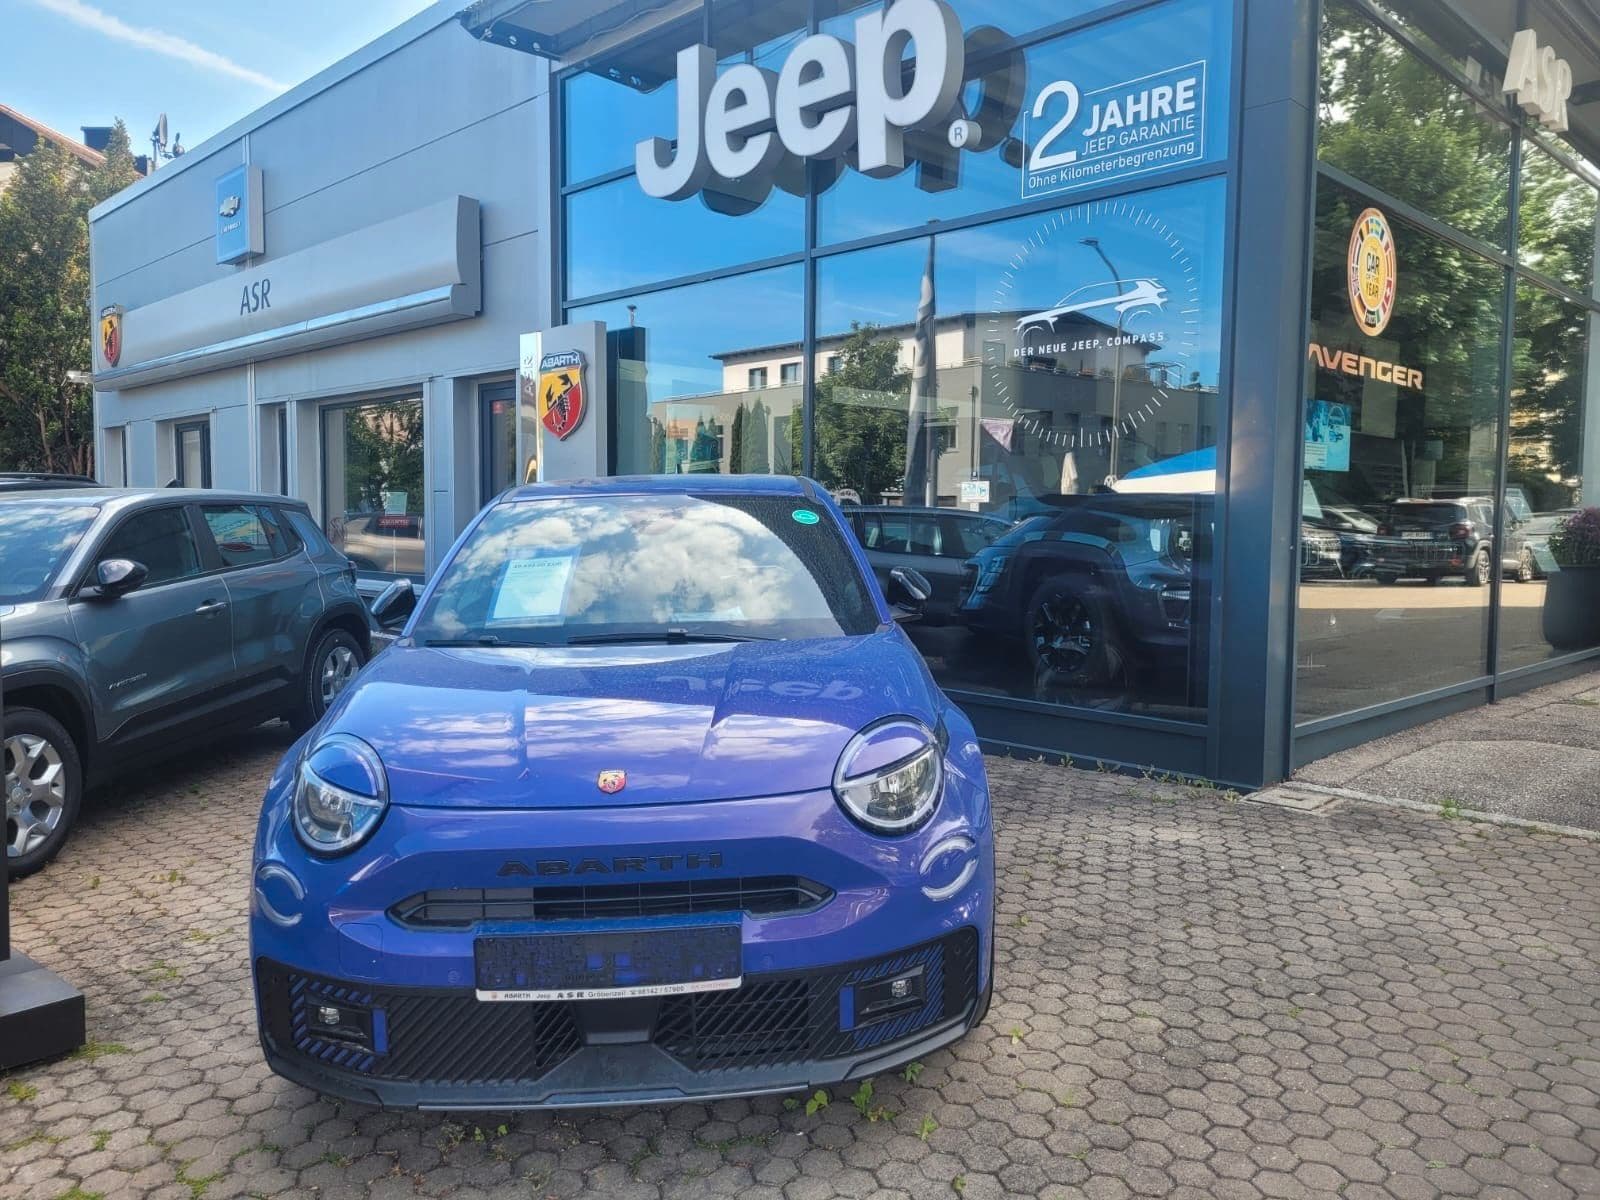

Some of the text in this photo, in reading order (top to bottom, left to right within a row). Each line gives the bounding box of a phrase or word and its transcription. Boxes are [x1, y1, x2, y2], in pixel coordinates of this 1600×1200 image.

[636, 0, 963, 200] Jeep
[1502, 28, 1572, 132] ASR
[1029, 80, 1079, 171] 2
[1082, 77, 1196, 137] JAHRE
[1081, 114, 1195, 156] JEEP GARANTIE
[1029, 141, 1194, 189] Ohne Kilometerbegrenzung
[240, 278, 271, 316] ASR
[541, 354, 580, 369] ABARTH
[1013, 348, 1034, 357] DER
[1038, 343, 1067, 354] NEUE
[1106, 331, 1165, 347] COMPASS
[1308, 343, 1423, 390] AVENGER
[496, 853, 723, 876] ABARTH
